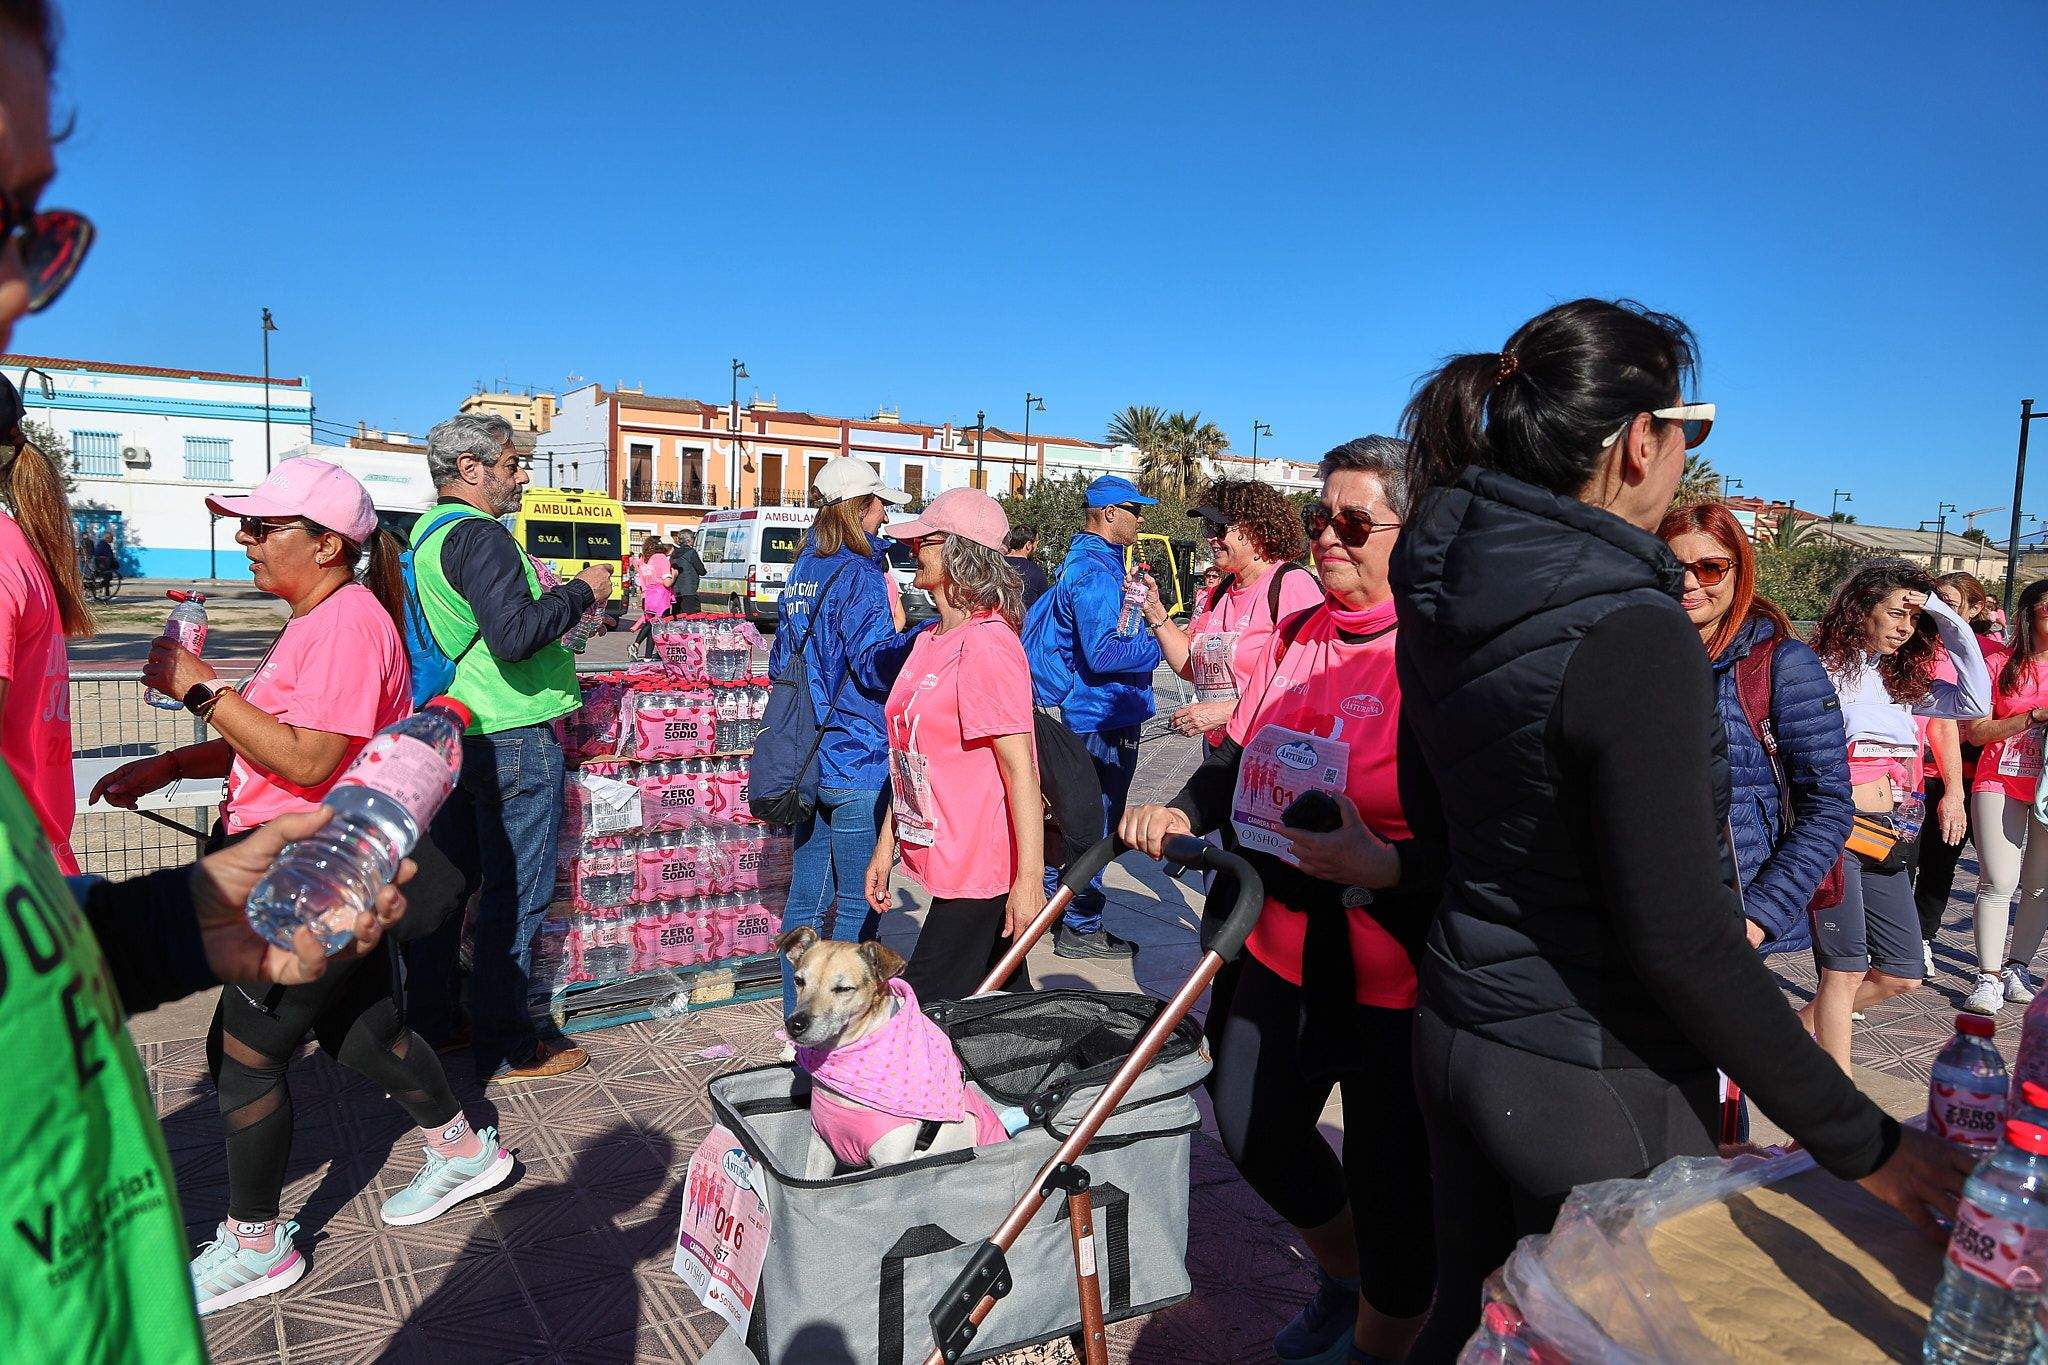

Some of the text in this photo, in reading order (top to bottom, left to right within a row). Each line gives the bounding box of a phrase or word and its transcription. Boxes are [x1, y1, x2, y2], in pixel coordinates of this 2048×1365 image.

[533, 503, 613, 518] AMBULANCIA
[764, 512, 815, 524] AMBULAN
[537, 535, 562, 544] S.V.A.
[587, 536, 611, 546] S.V.A.
[665, 647, 687, 655] ZERO
[666, 654, 688, 663] SODIO
[664, 722, 698, 732] ZERO
[664, 731, 699, 740] SODIO
[661, 788, 695, 799] ZERO
[1272, 785, 1294, 807] 01
[661, 797, 696, 807] SODIO
[1241, 829, 1279, 848] OYSHO
[739, 852, 770, 863] ZERO
[662, 861, 696, 873] ZERO
[661, 869, 696, 881] SODIO
[737, 917, 769, 928] ZERO
[660, 926, 694, 938] ZERO
[736, 925, 769, 936] SODIO
[660, 935, 695, 947] SODIO
[1946, 1104, 1996, 1121] ZERO
[714, 1206, 746, 1251] 016
